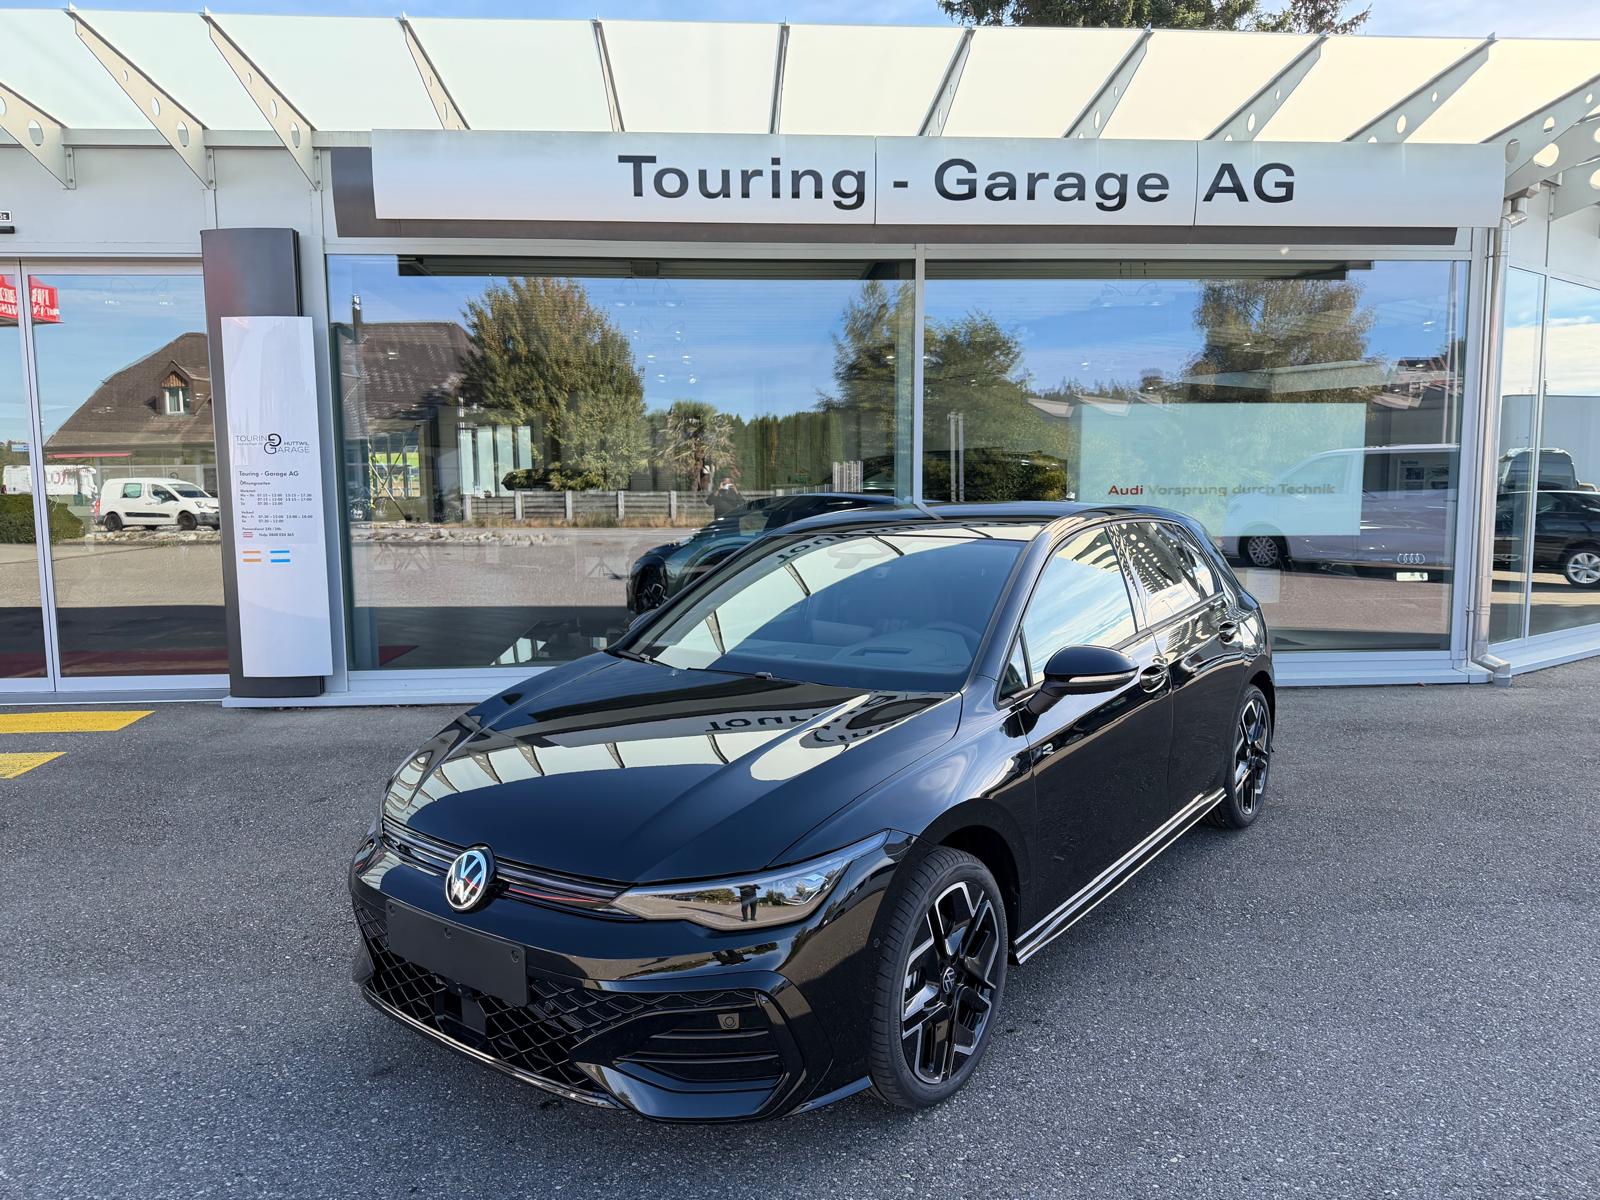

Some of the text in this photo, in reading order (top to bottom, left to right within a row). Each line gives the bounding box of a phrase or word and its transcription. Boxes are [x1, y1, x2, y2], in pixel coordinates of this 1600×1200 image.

[618, 155, 1295, 211] Touring - Garage AG
[264, 442, 310, 454] GARAGE
[1108, 484, 1335, 497] Audi Vorsprung durch Technik
